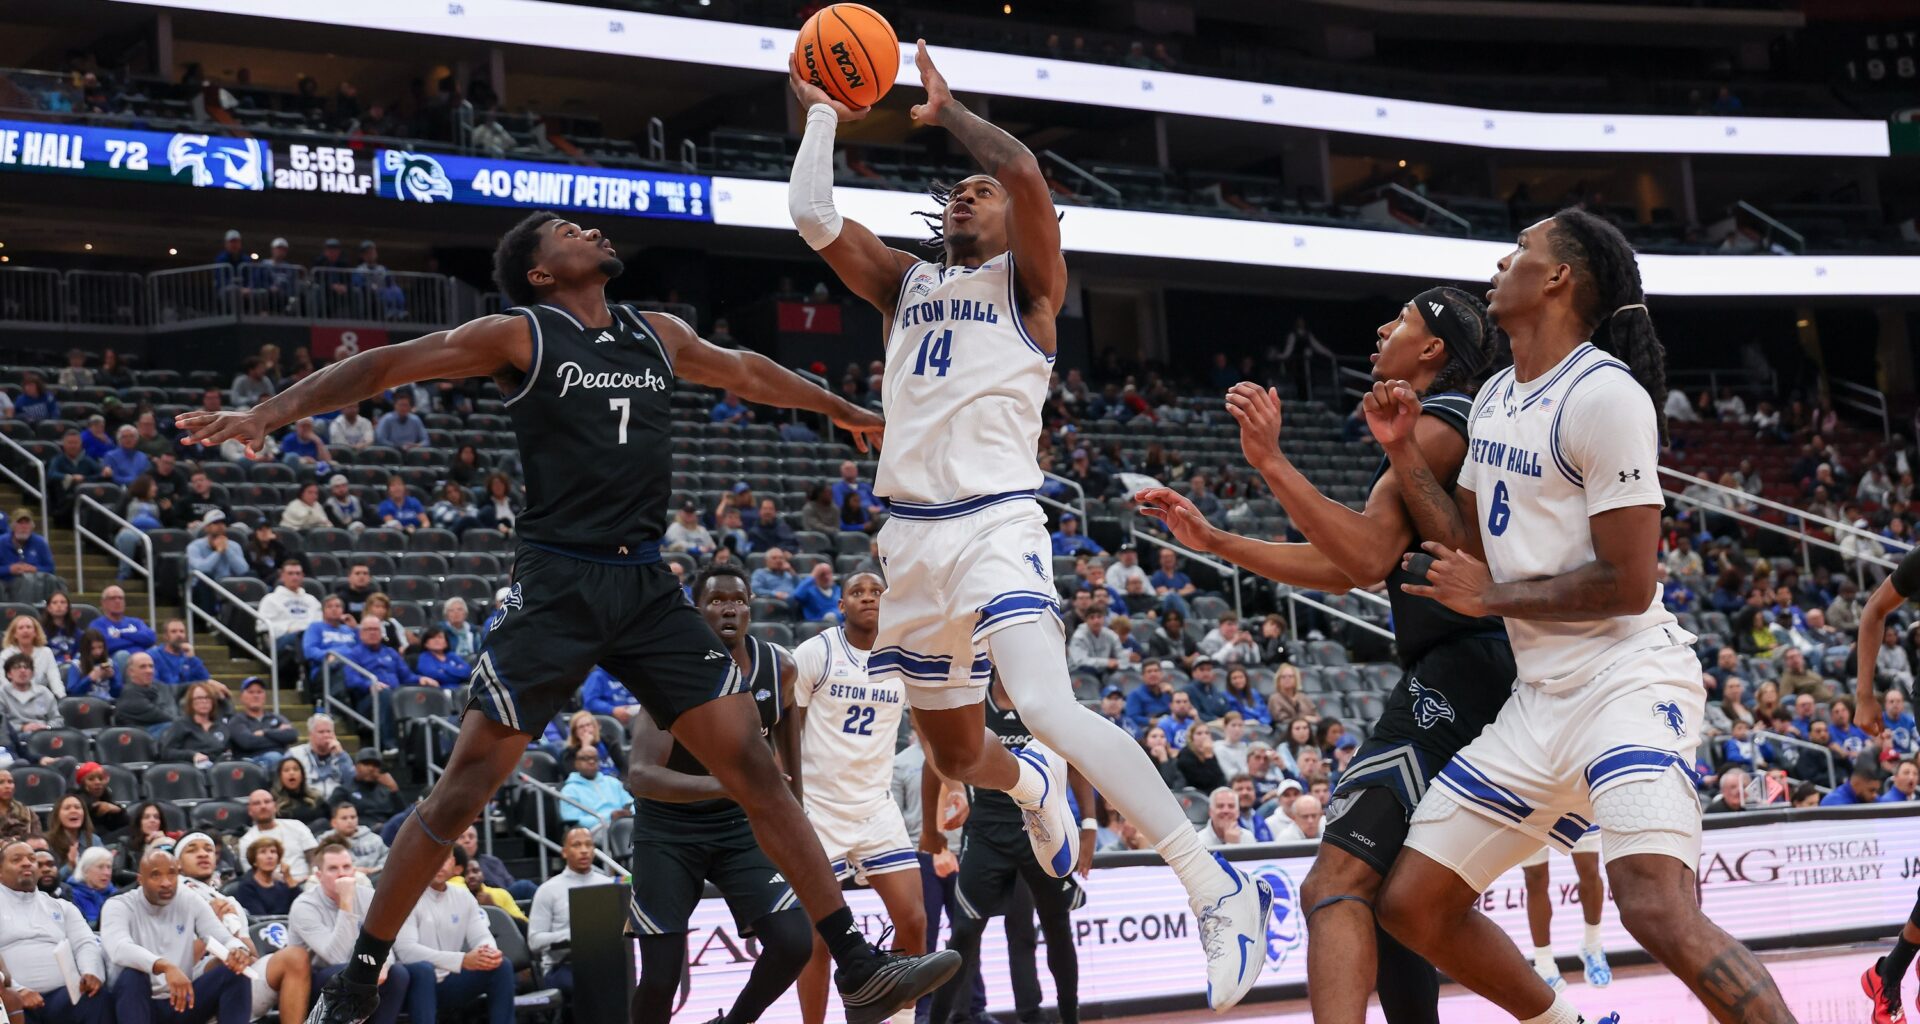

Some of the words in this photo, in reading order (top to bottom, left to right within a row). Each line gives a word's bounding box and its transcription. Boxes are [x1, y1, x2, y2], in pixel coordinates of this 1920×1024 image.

[831, 41, 865, 89] NCAA
[21, 131, 86, 169] HALL
[105, 140, 149, 171] 72
[289, 144, 355, 174] 5:55
[274, 168, 318, 191] 2ND
[319, 170, 372, 195] HALF
[471, 169, 512, 198] 40
[512, 170, 574, 206] SAINT
[573, 174, 650, 212] PETER'S
[801, 306, 816, 329] 7
[950, 298, 998, 325] HALL
[341, 331, 359, 355] 8
[912, 329, 953, 377] 14
[556, 361, 666, 398] Peacocks
[609, 398, 631, 444] 7
[1506, 447, 1542, 478] HALL
[1487, 479, 1511, 537] 6
[830, 684, 867, 700] SETON
[871, 688, 899, 704] HALL
[842, 704, 876, 736] 22
[1786, 839, 1885, 863] PHYSICAL
[1788, 862, 1884, 886] THERAPY
